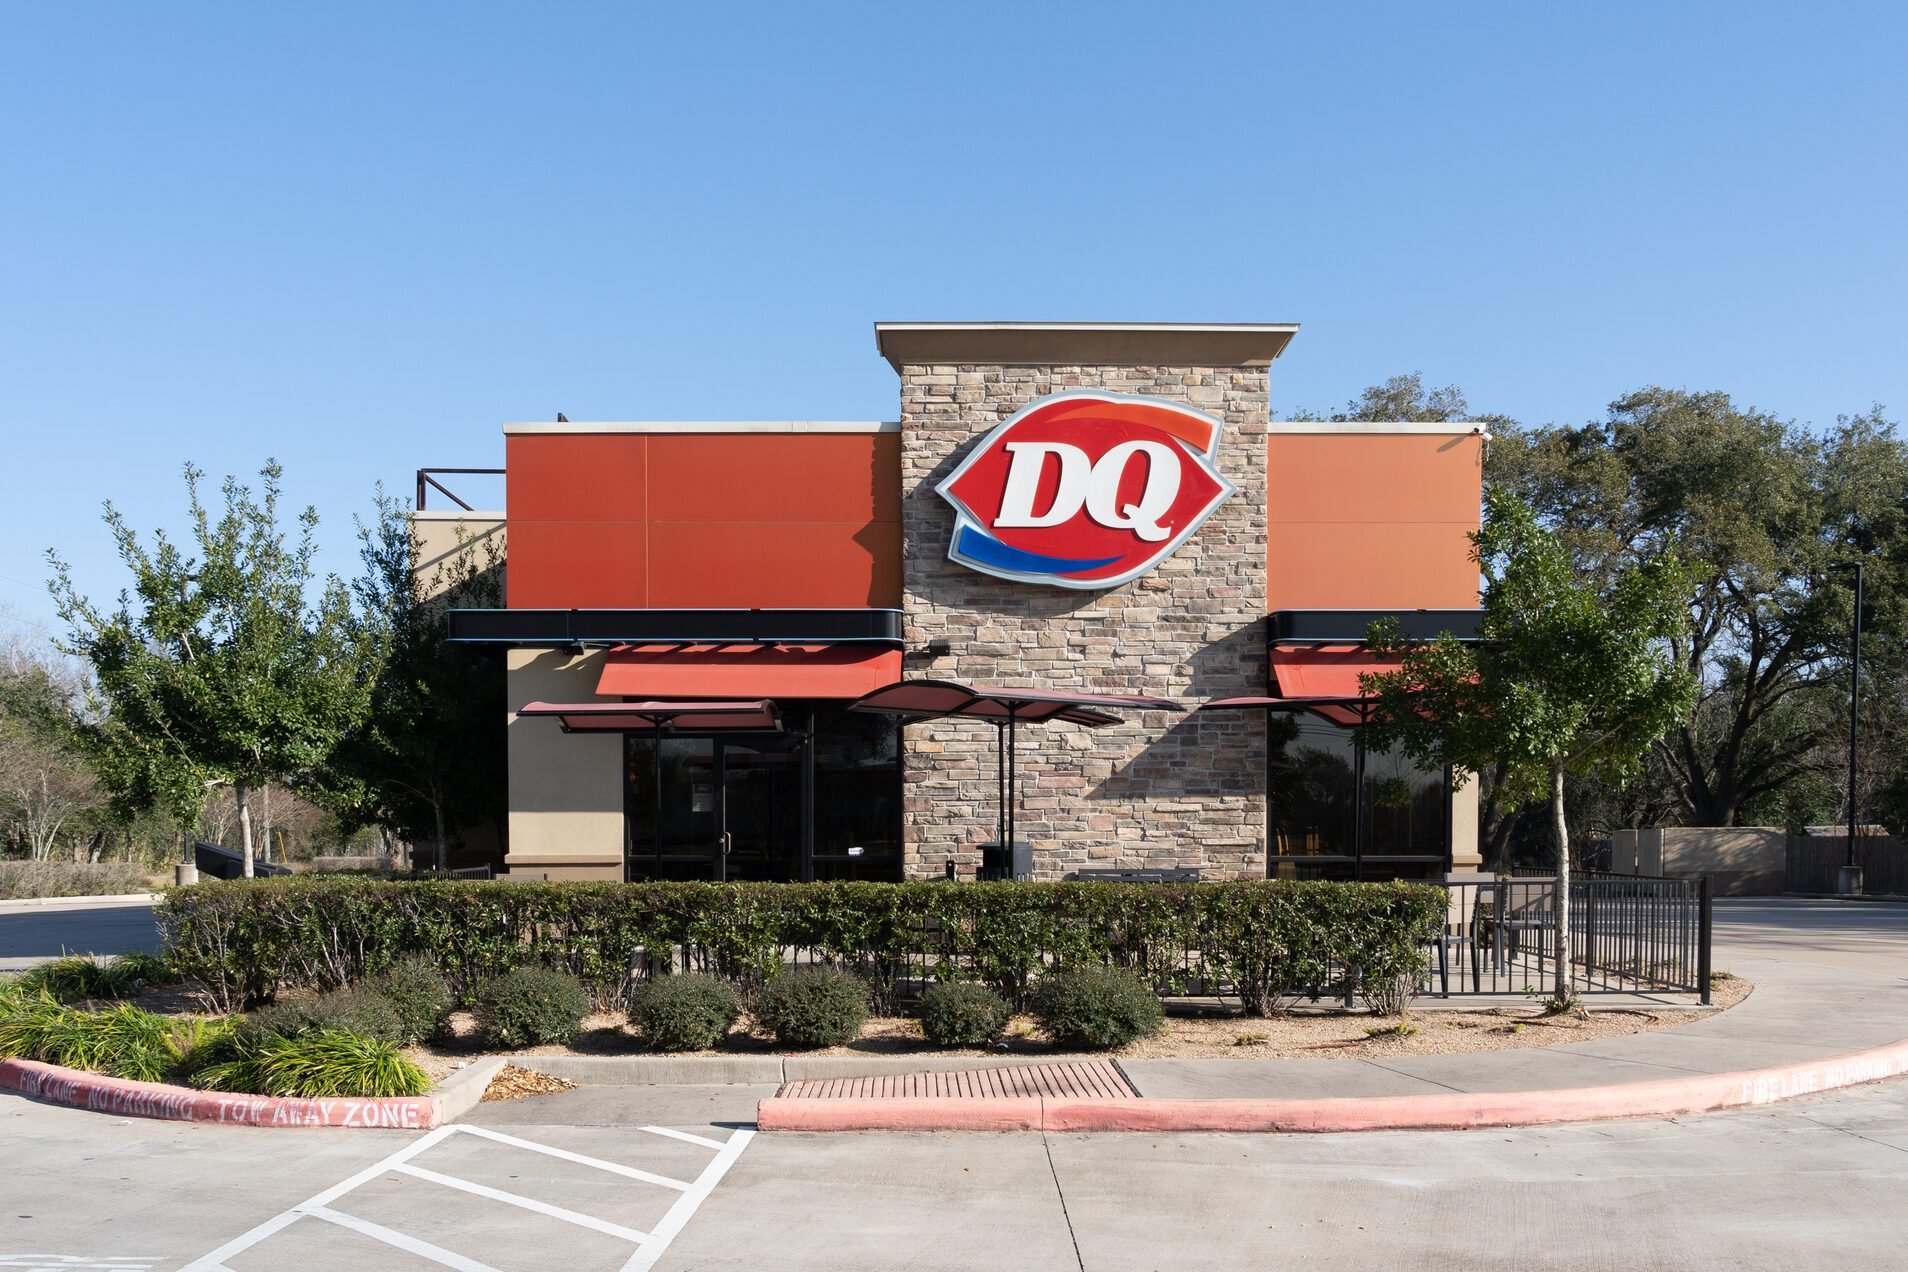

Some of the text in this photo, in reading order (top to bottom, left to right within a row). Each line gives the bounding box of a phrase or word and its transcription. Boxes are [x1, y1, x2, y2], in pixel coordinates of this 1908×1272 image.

[993, 440, 1181, 542] DQ
[46, 1072, 80, 1104] LANE
[88, 1086, 110, 1110] NO
[112, 1088, 196, 1120] PARKING
[218, 1100, 268, 1123] TOW
[272, 1101, 336, 1125] AWAY
[343, 1102, 420, 1128] ZONE
[1824, 1066, 1843, 1089] NO
